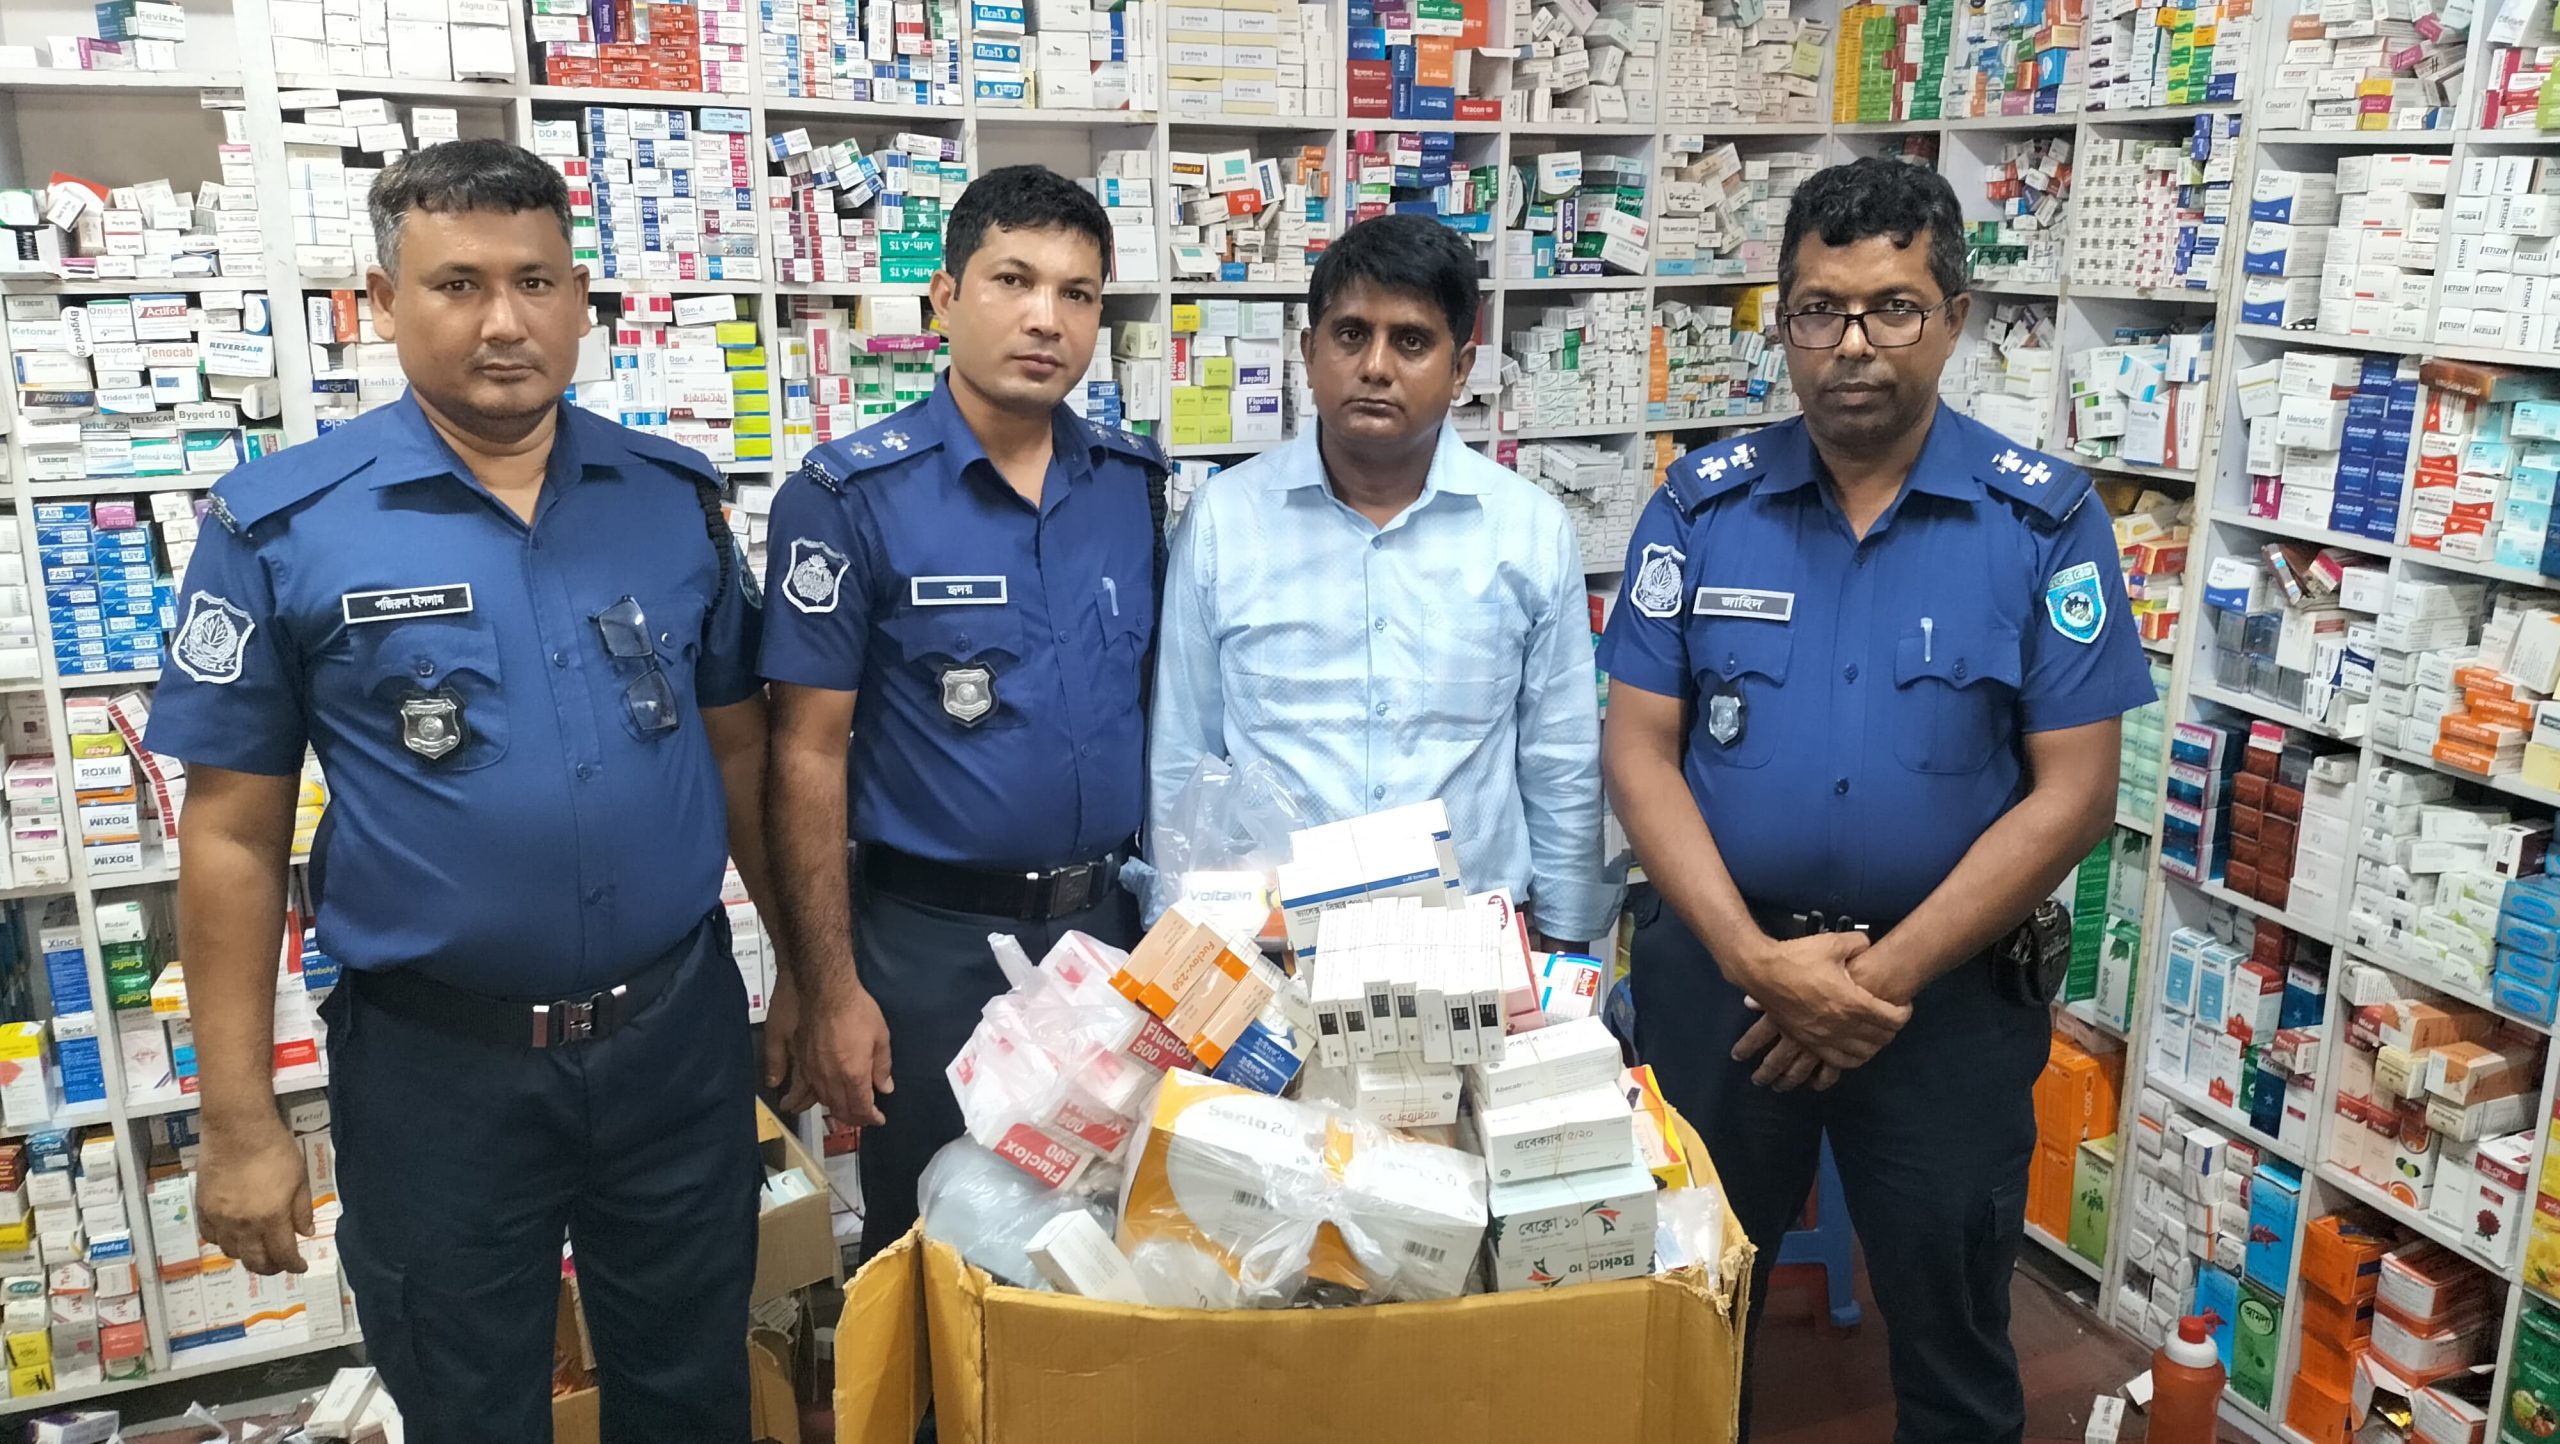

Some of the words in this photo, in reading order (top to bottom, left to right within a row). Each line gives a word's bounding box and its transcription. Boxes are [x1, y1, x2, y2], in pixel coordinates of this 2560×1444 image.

[670, 119, 684, 129] 200
[147, 306, 179, 317] Actifol
[145, 346, 193, 358] Tenocab
[209, 341, 264, 353] REVERSAIR
[1248, 396, 1276, 405] Fluclox
[179, 410, 214, 420] Bygerd
[219, 410, 231, 419] 10
[39, 508, 63, 519] FAST
[50, 570, 73, 580] FAST
[1721, 595, 1764, 611] জাহিদ
[81, 766, 122, 777] ROXIM
[90, 815, 130, 827] ROXIM
[94, 854, 134, 866] ROXIM
[1145, 1021, 1196, 1063] Fluclox
[1131, 1039, 1161, 1062] 500
[1044, 1142, 1078, 1169] 500
[1001, 1137, 1067, 1188] Fluclox
